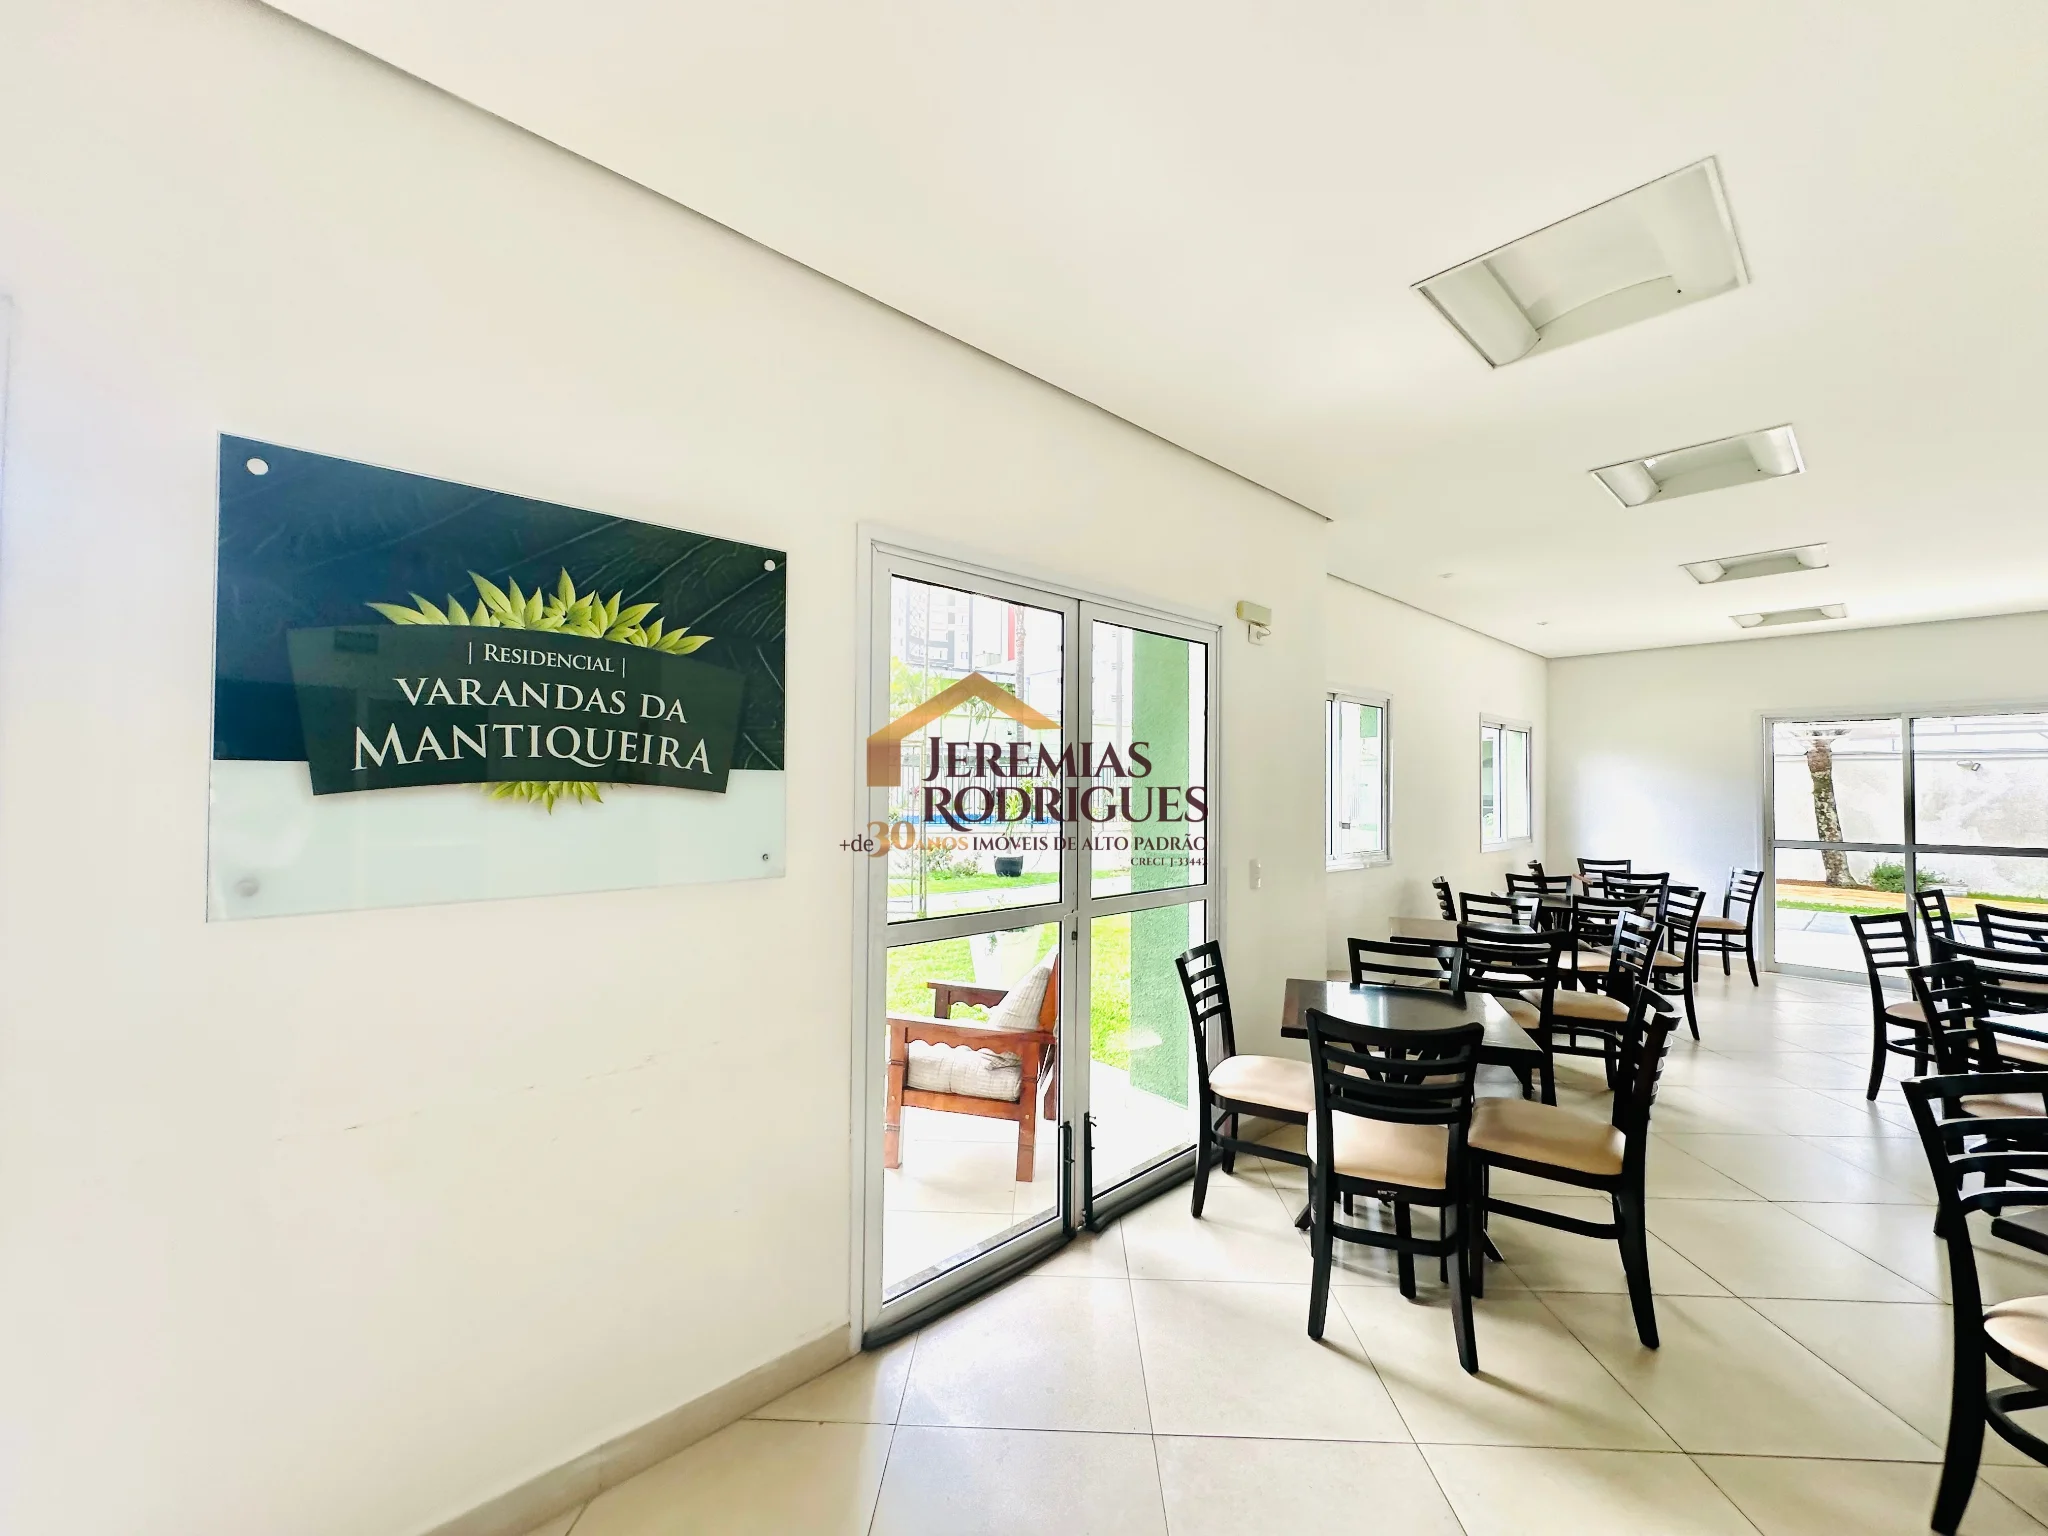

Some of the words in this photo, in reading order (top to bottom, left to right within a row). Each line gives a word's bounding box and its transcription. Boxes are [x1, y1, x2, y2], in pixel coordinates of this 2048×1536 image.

[484, 643, 615, 673] RESIDENCIAL
[393, 676, 627, 715] VARANDAS
[640, 693, 689, 725] DA
[351, 722, 714, 775] MANTIQUEIRA
